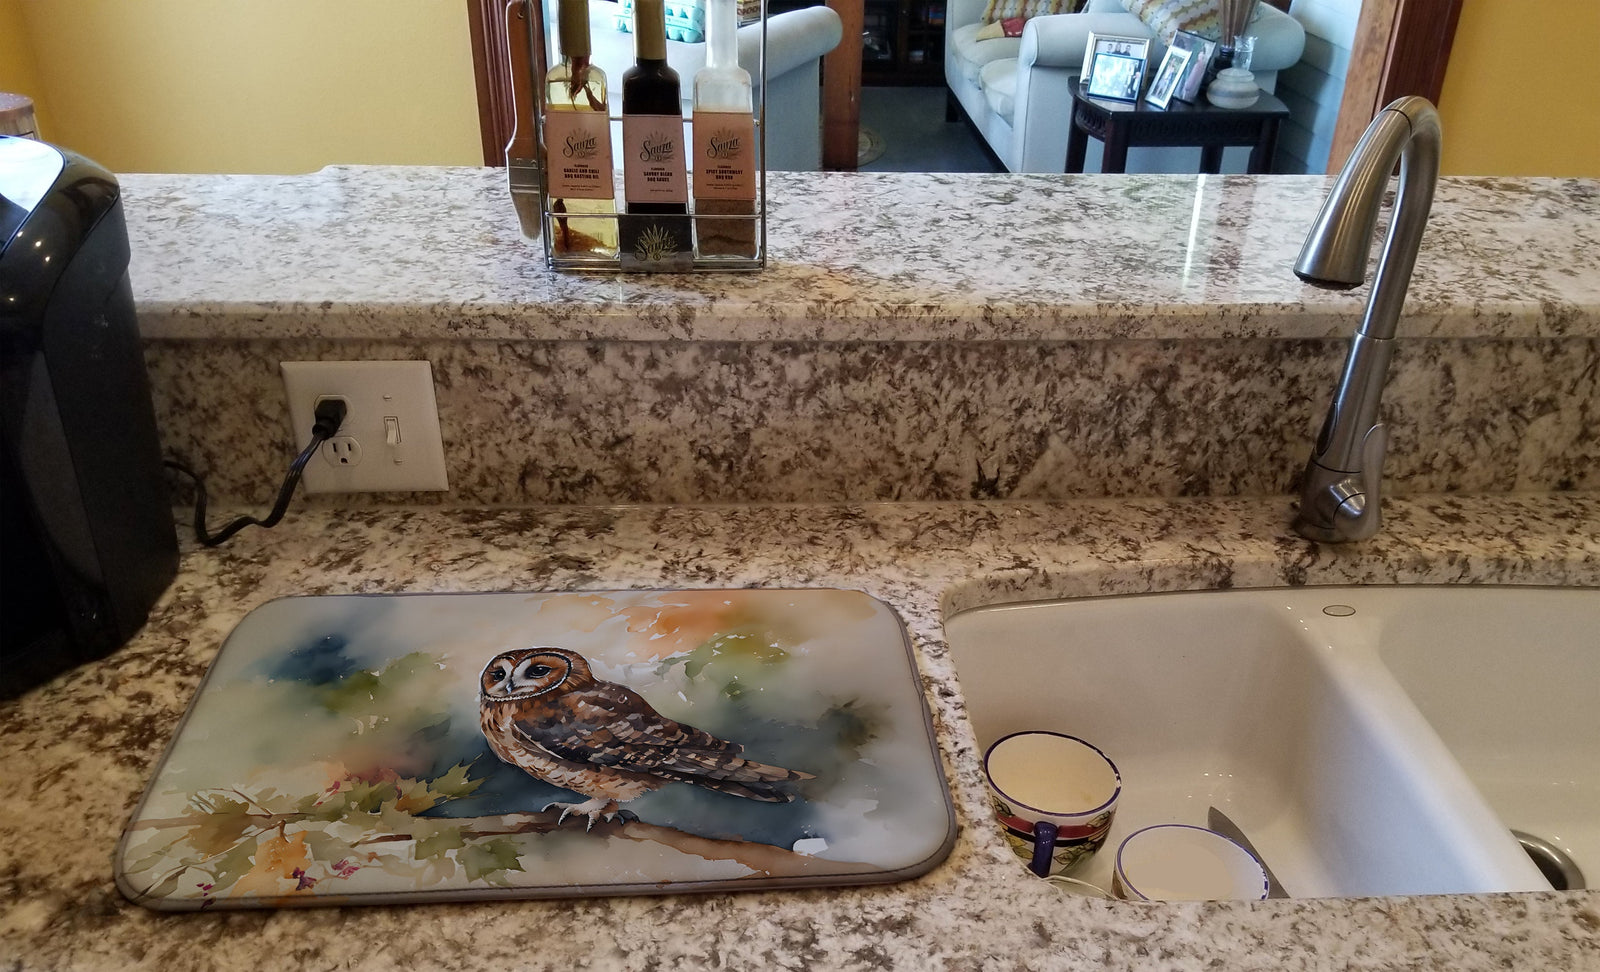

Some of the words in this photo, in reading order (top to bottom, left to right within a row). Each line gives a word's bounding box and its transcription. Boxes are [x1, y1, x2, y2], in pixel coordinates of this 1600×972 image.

[563, 136, 597, 158] Sauza
[640, 140, 673, 162] Sauza
[706, 136, 740, 159] Sauza
